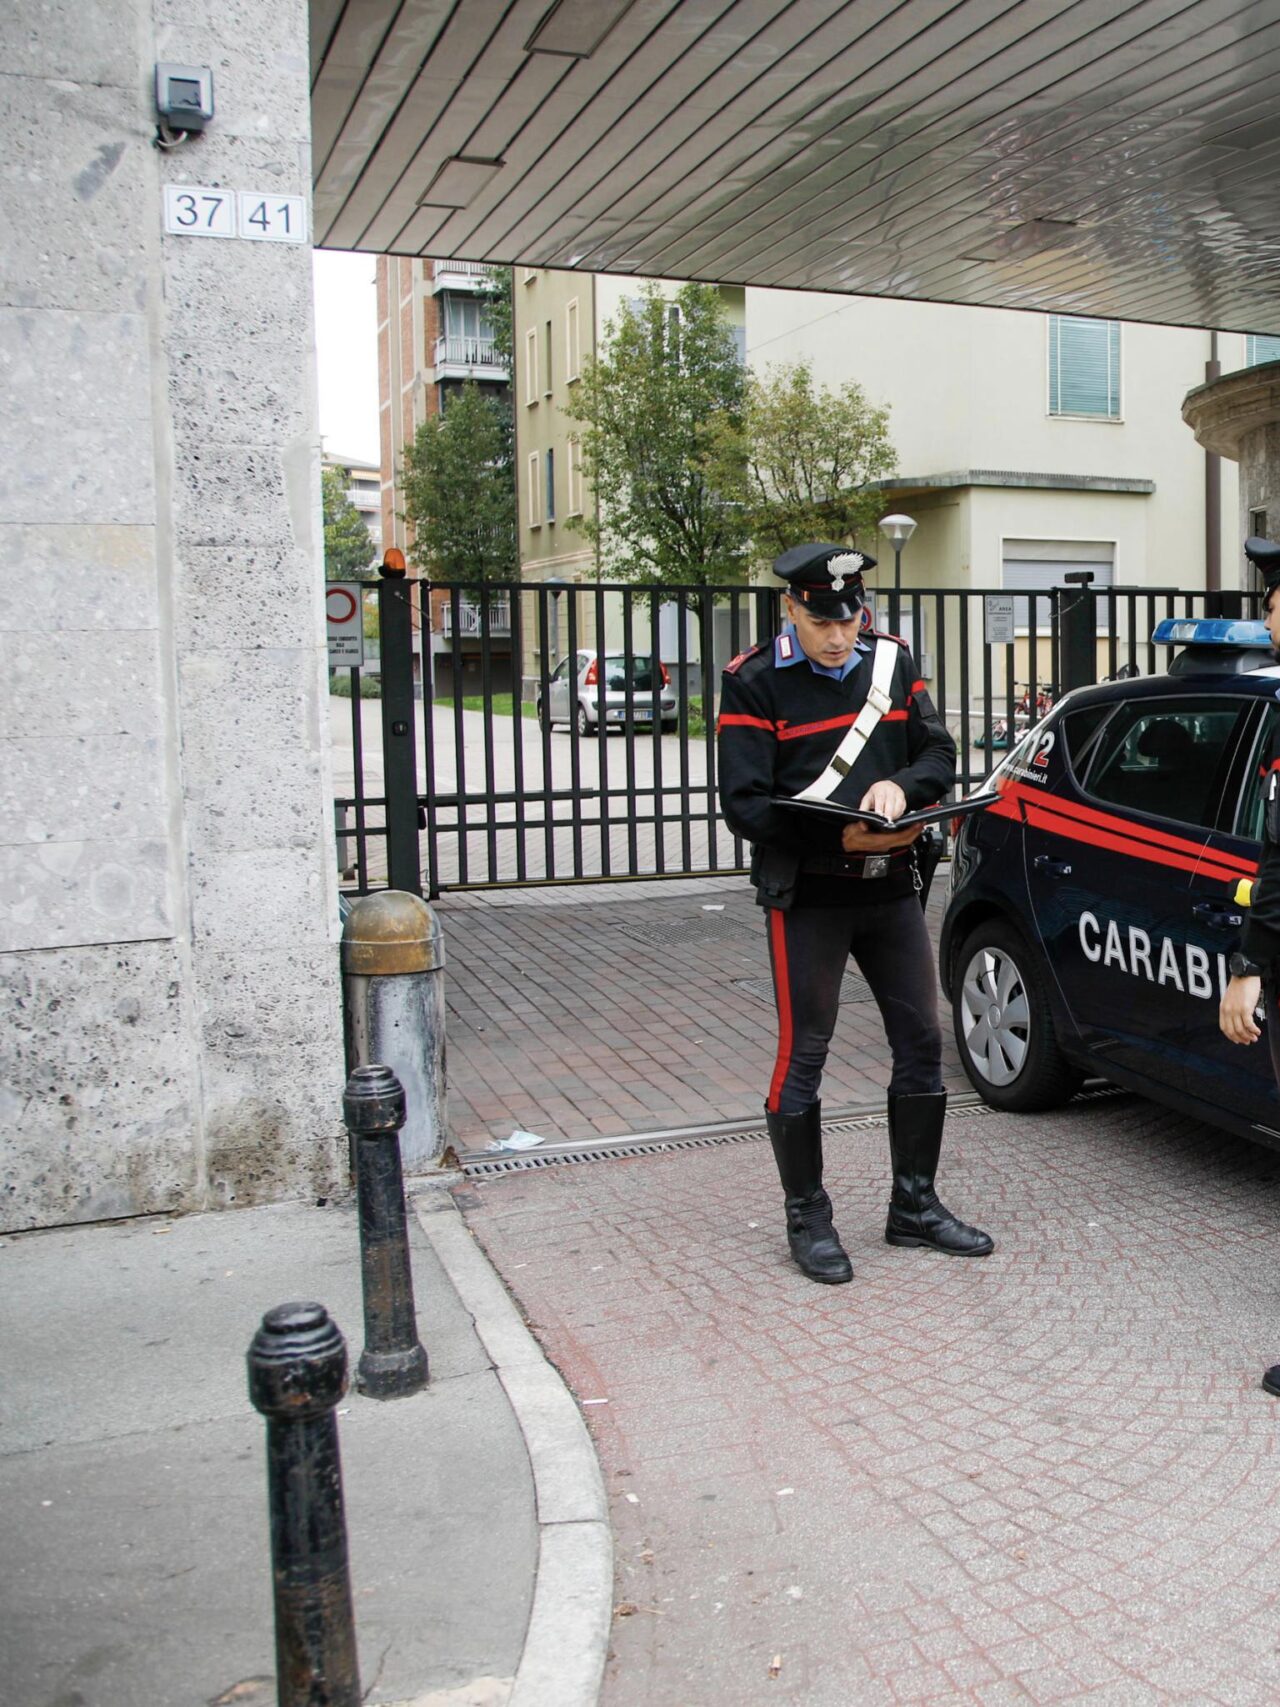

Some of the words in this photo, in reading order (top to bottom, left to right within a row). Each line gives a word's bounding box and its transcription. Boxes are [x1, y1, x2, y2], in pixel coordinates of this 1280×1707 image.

[176, 194, 224, 227] 37
[248, 201, 291, 233] 41
[1077, 910, 1229, 1003] CARABI
